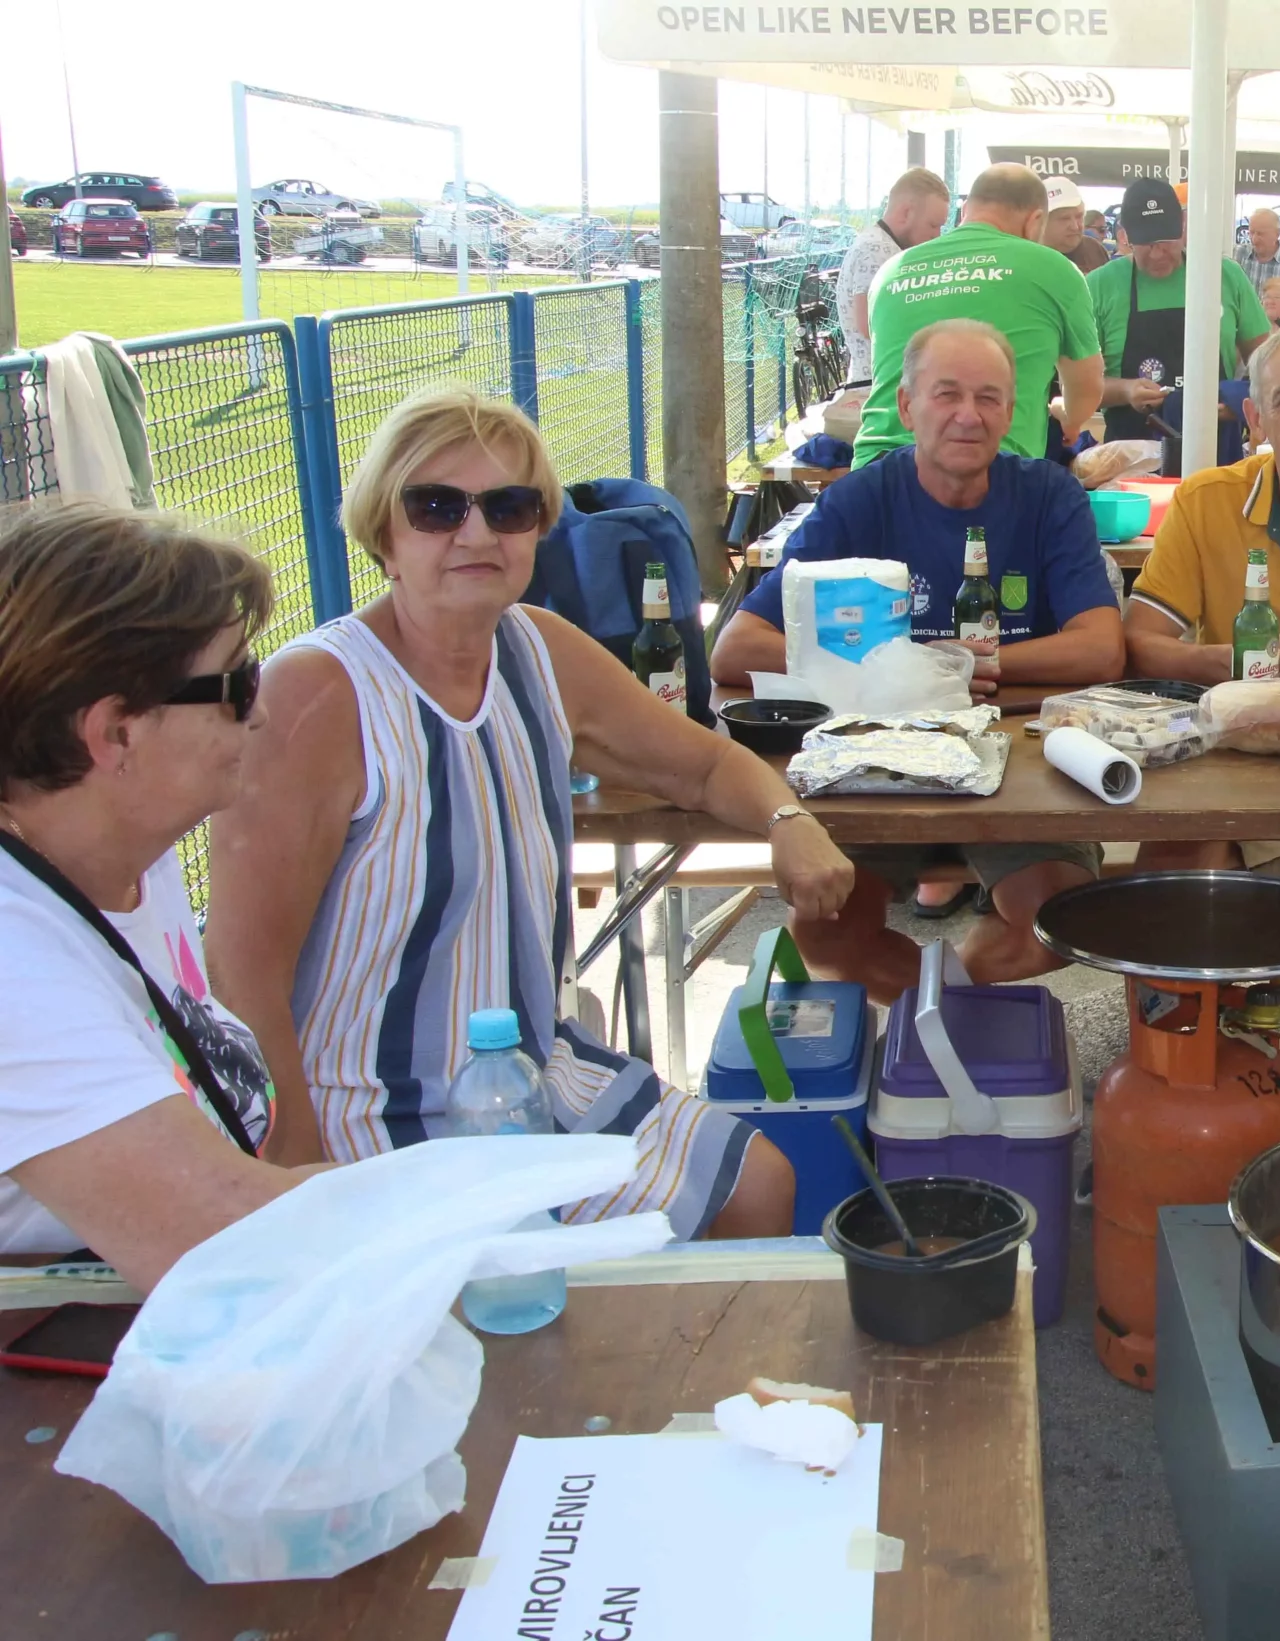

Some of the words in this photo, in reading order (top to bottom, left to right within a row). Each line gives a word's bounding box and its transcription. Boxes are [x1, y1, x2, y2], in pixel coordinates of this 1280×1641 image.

[656, 5, 746, 33] OPEN
[757, 6, 832, 35] LIKE
[841, 7, 957, 35] NEVER
[968, 8, 1109, 36] BEFORE
[900, 262, 928, 275] EKO
[933, 254, 998, 269] UDRUGA
[905, 285, 981, 304] Domašinec
